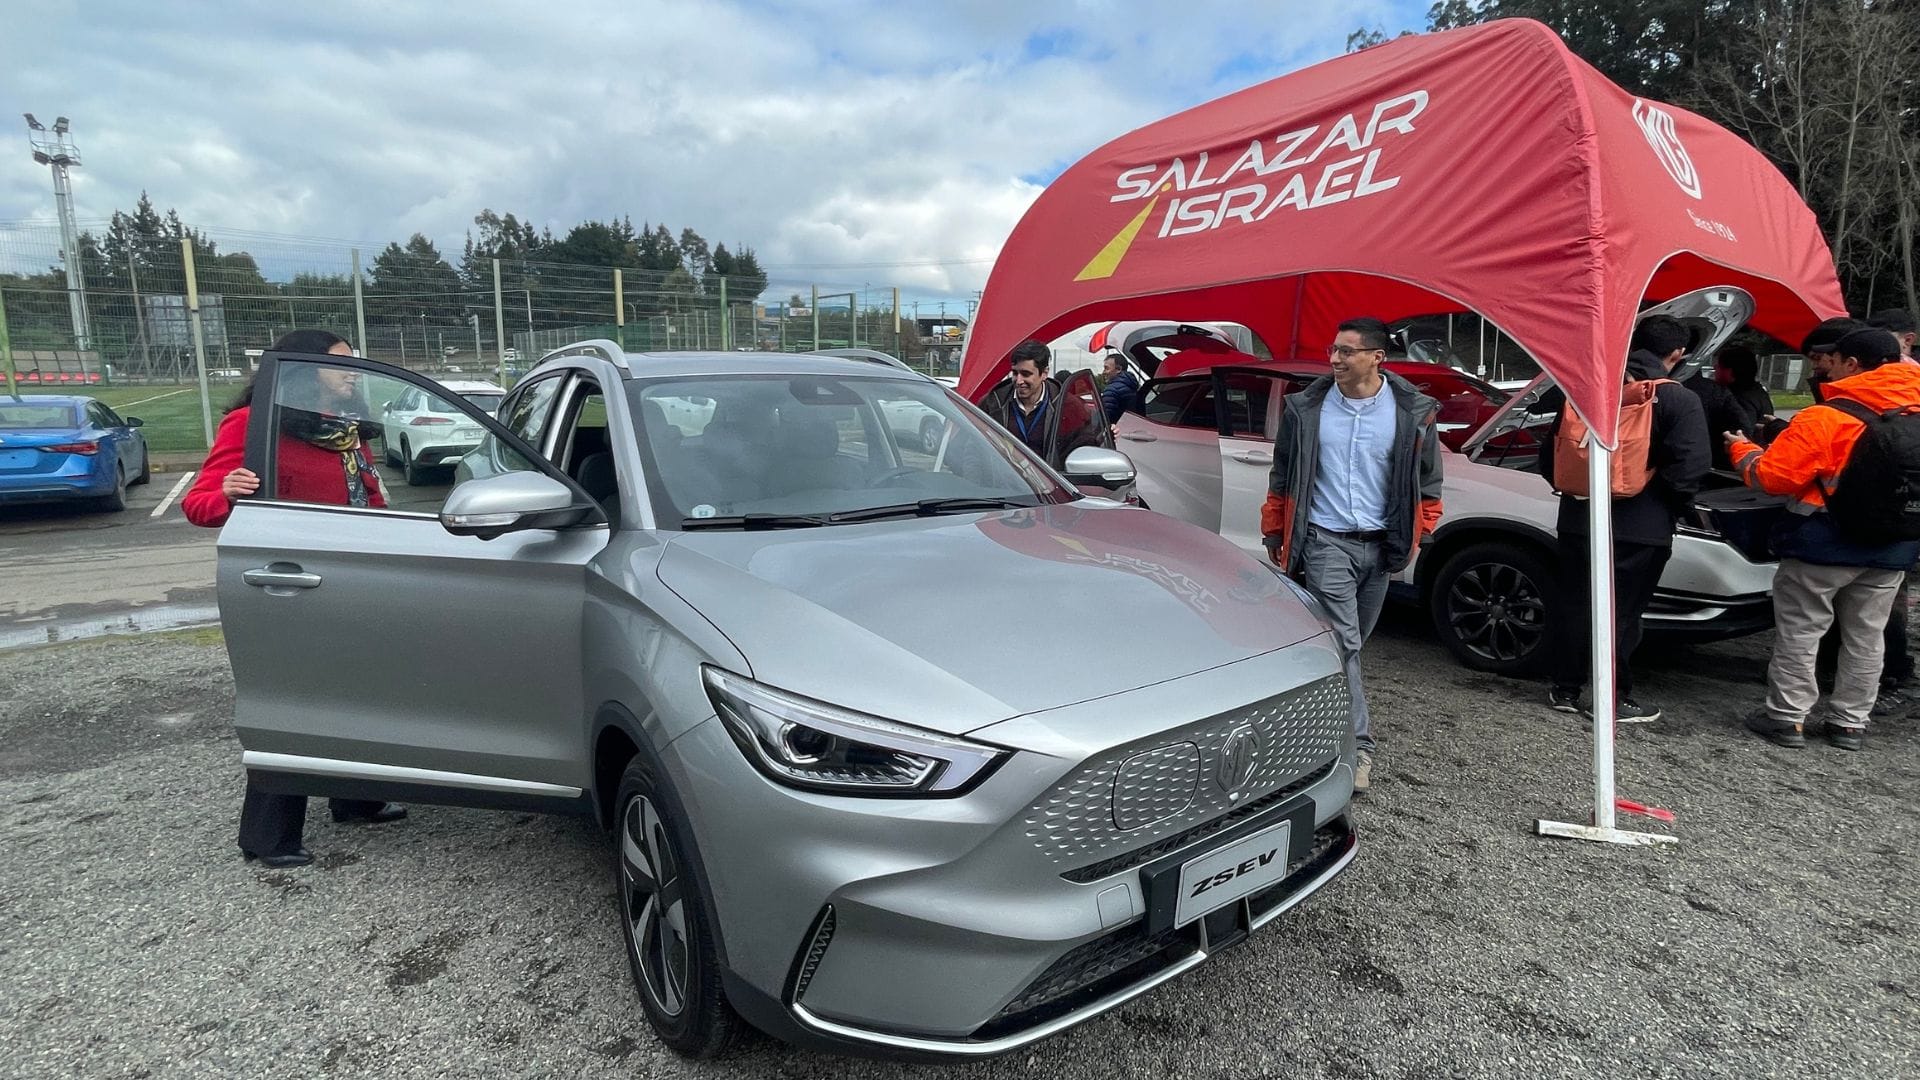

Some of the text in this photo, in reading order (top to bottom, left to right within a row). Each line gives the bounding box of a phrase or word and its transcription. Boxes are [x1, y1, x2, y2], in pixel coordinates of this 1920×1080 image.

[1110, 89, 1429, 203] SALAZAR
[1158, 148, 1401, 238] ISRAEL
[1190, 848, 1278, 898] ZSEV
